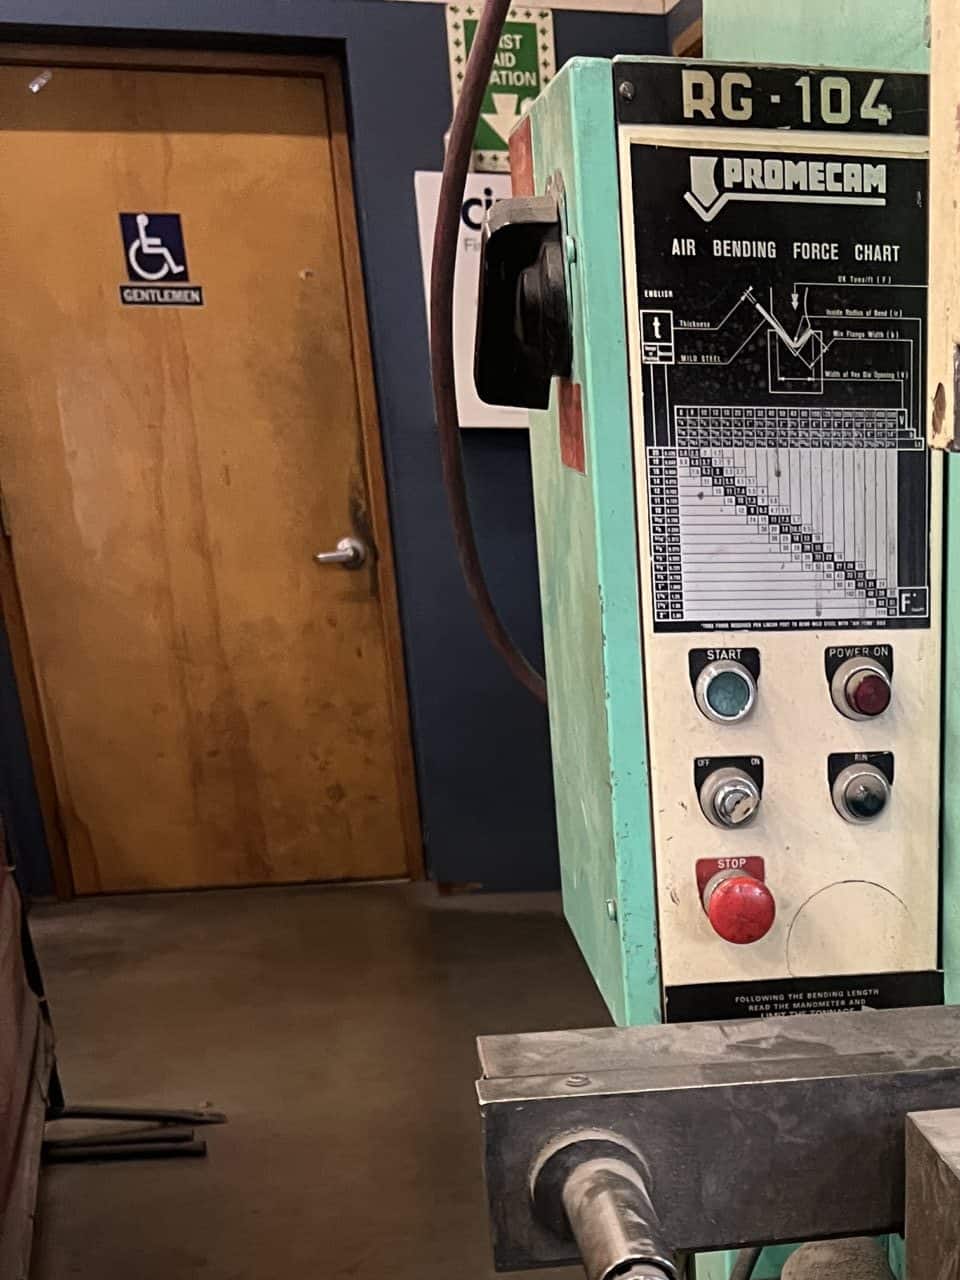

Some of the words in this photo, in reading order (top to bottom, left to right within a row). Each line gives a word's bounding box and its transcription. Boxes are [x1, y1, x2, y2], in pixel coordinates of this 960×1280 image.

[493, 52, 517, 67] AID
[489, 70, 537, 86] ATION
[681, 69, 752, 121] RG
[795, 76, 893, 126] 104
[723, 157, 887, 193] PROMECAM
[671, 238, 697, 257] AIR
[713, 240, 777, 259] BENDING
[793, 242, 839, 261] FORCE
[854, 244, 901, 263] CHART
[123, 288, 200, 303] GENTLEMEN
[706, 649, 742, 661] START
[829, 647, 869, 657] POWER
[873, 647, 889, 656] ON
[697, 759, 710, 767] OFF
[750, 758, 761, 766] ON
[854, 753, 868, 761] RUN
[717, 859, 747, 869] STOP
[735, 993, 785, 1003] FOLLOWING
[807, 991, 844, 999] BENDING
[847, 988, 879, 996] LENGTH
[792, 1000, 845, 1009] MANOMETER
[848, 998, 866, 1006] AND
